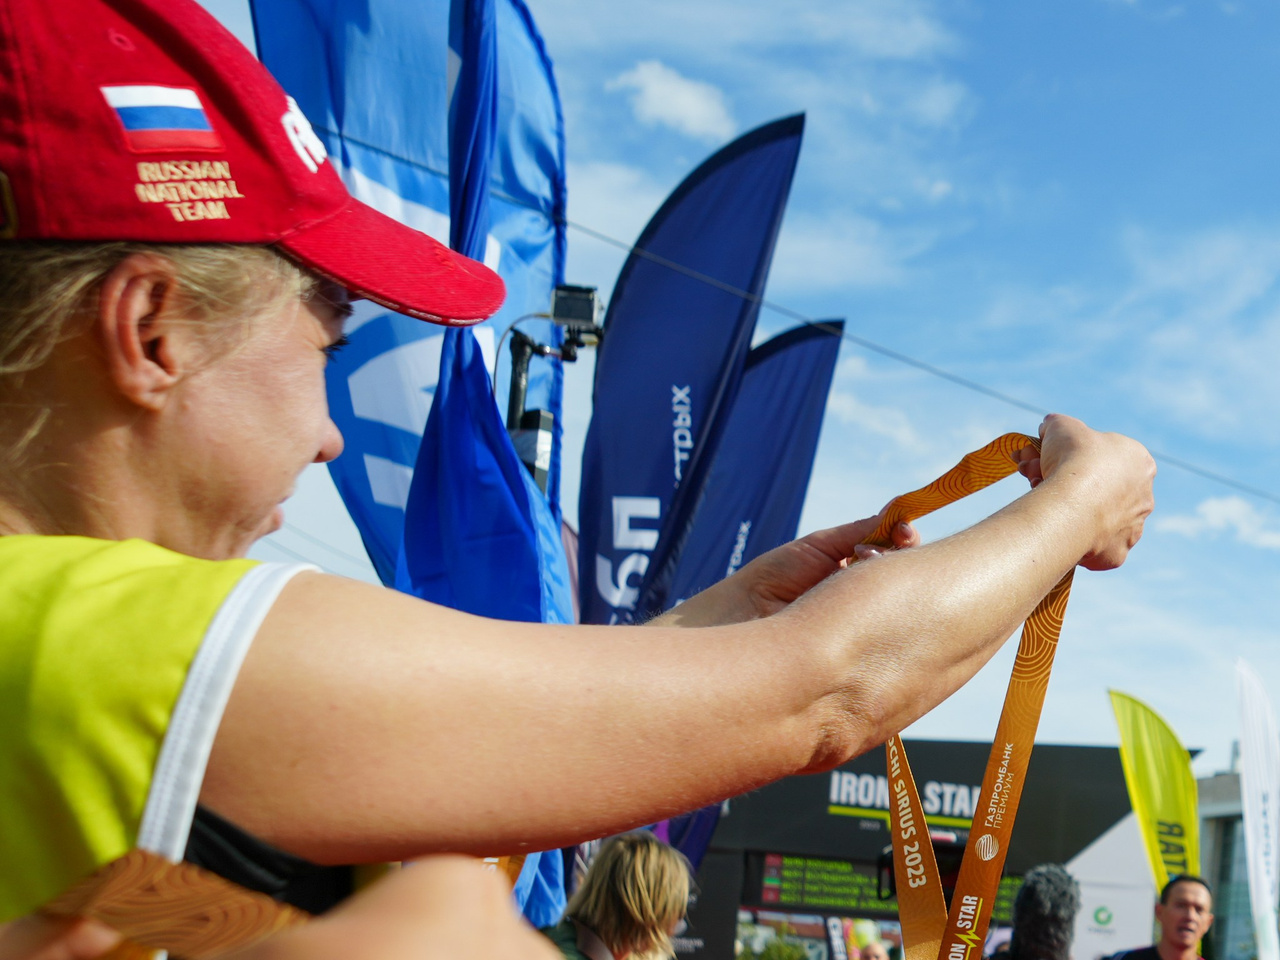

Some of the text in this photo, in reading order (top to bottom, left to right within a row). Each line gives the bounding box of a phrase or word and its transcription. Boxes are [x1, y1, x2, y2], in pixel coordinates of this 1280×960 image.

[137, 160, 231, 182] RUSSIAN
[134, 180, 245, 203] NATIONAL
[165, 201, 230, 222] TEAM
[829, 770, 890, 808] IRON
[985, 742, 1014, 828] ГАЗПРОМБАНК
[993, 772, 1015, 829] ПРЕМИУМ
[893, 779, 917, 840] SIRIUS
[903, 841, 927, 889] 2023
[957, 894, 979, 929] STAR
